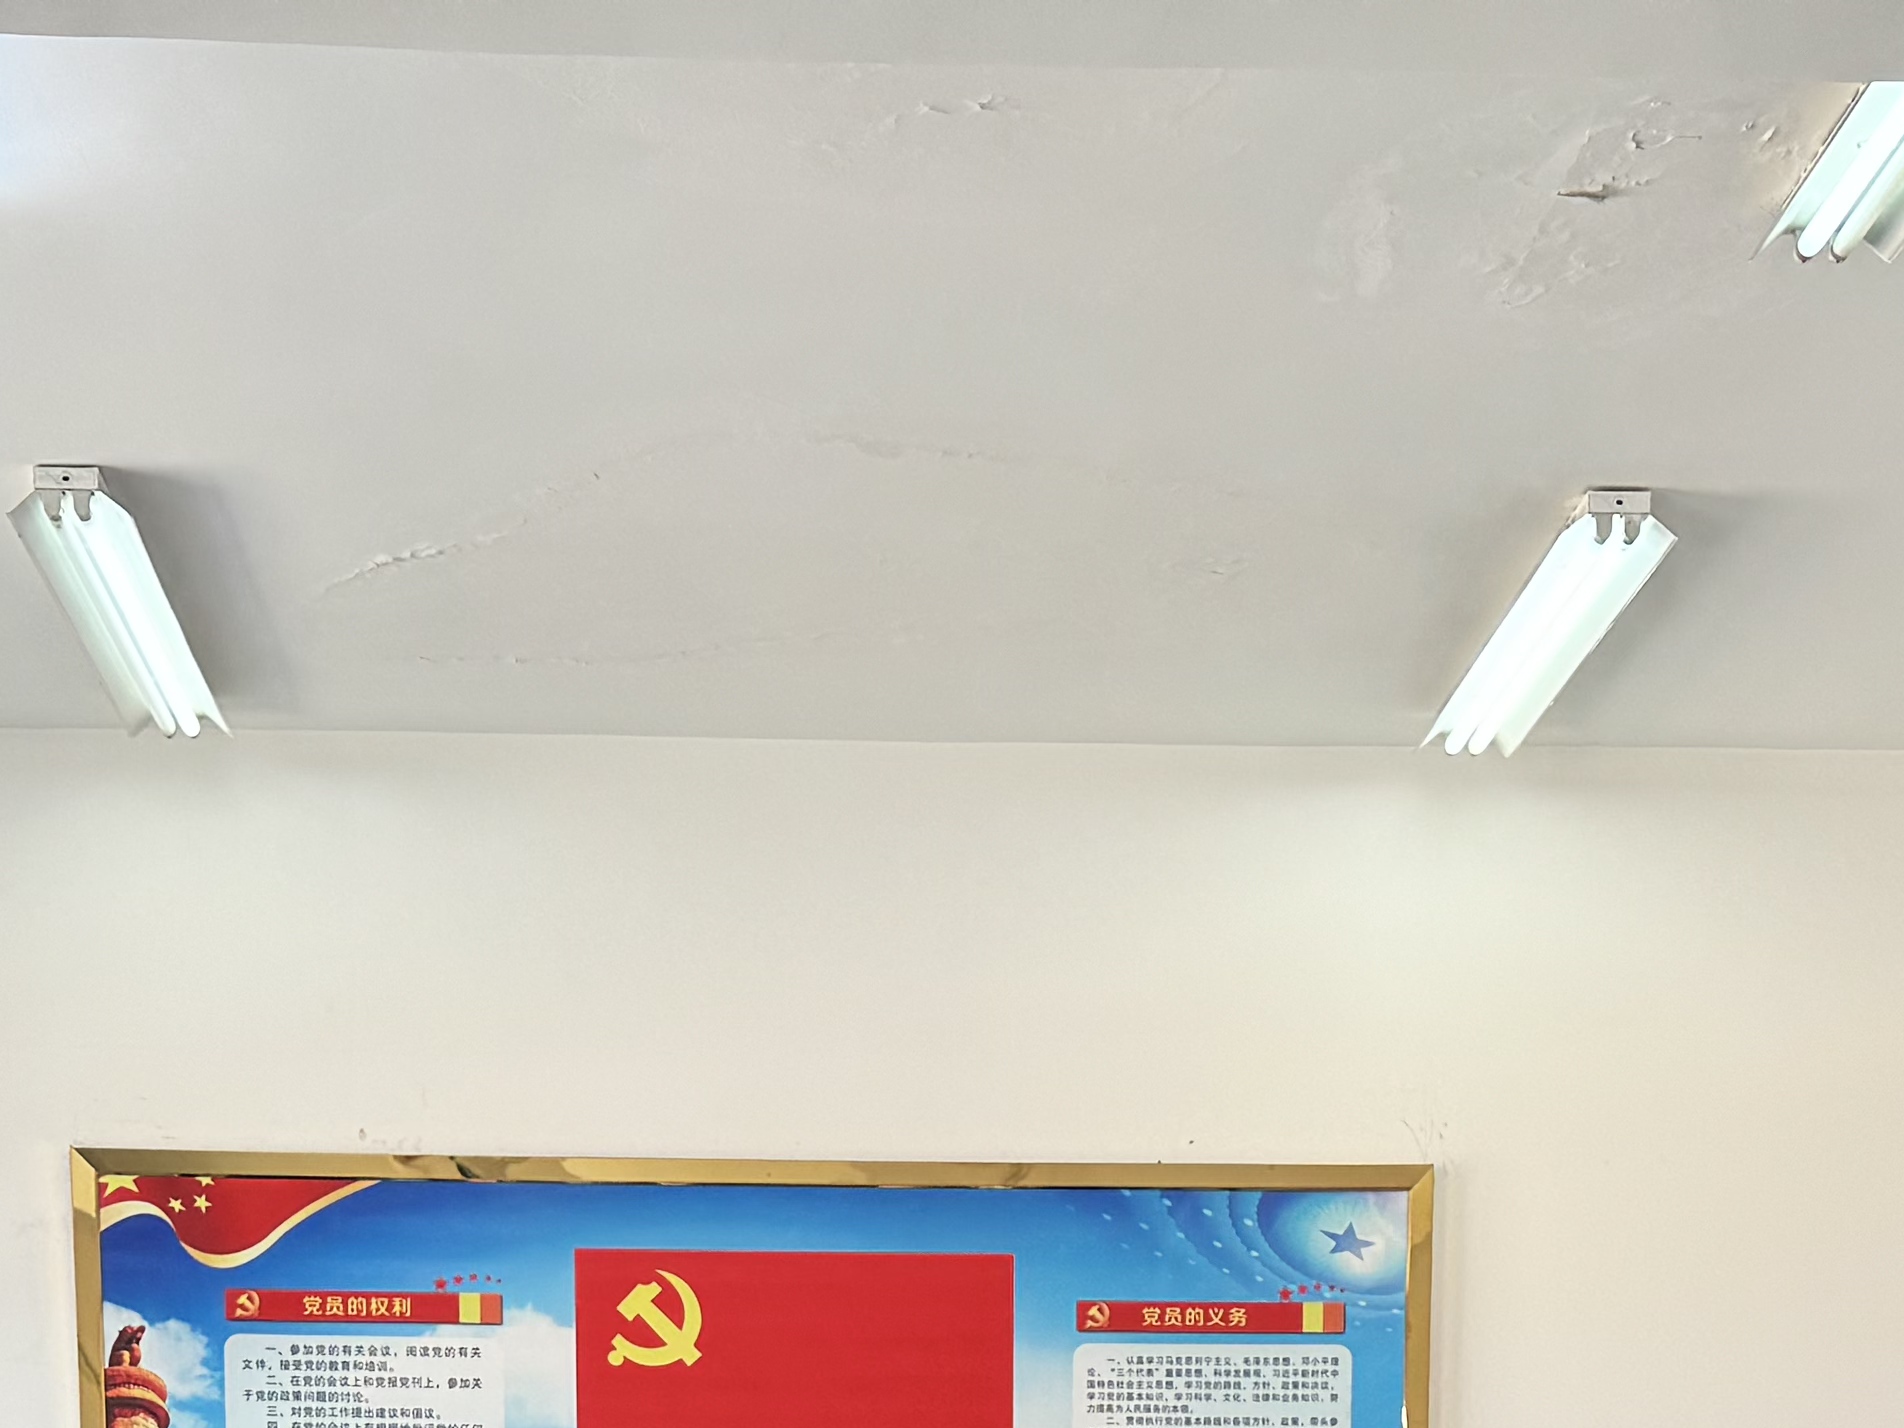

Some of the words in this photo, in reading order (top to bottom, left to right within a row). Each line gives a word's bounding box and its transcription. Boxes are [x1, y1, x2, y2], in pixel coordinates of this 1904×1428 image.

[303, 1295, 412, 1317] 党员的权利
[1142, 1307, 1248, 1327] 党员的义务
